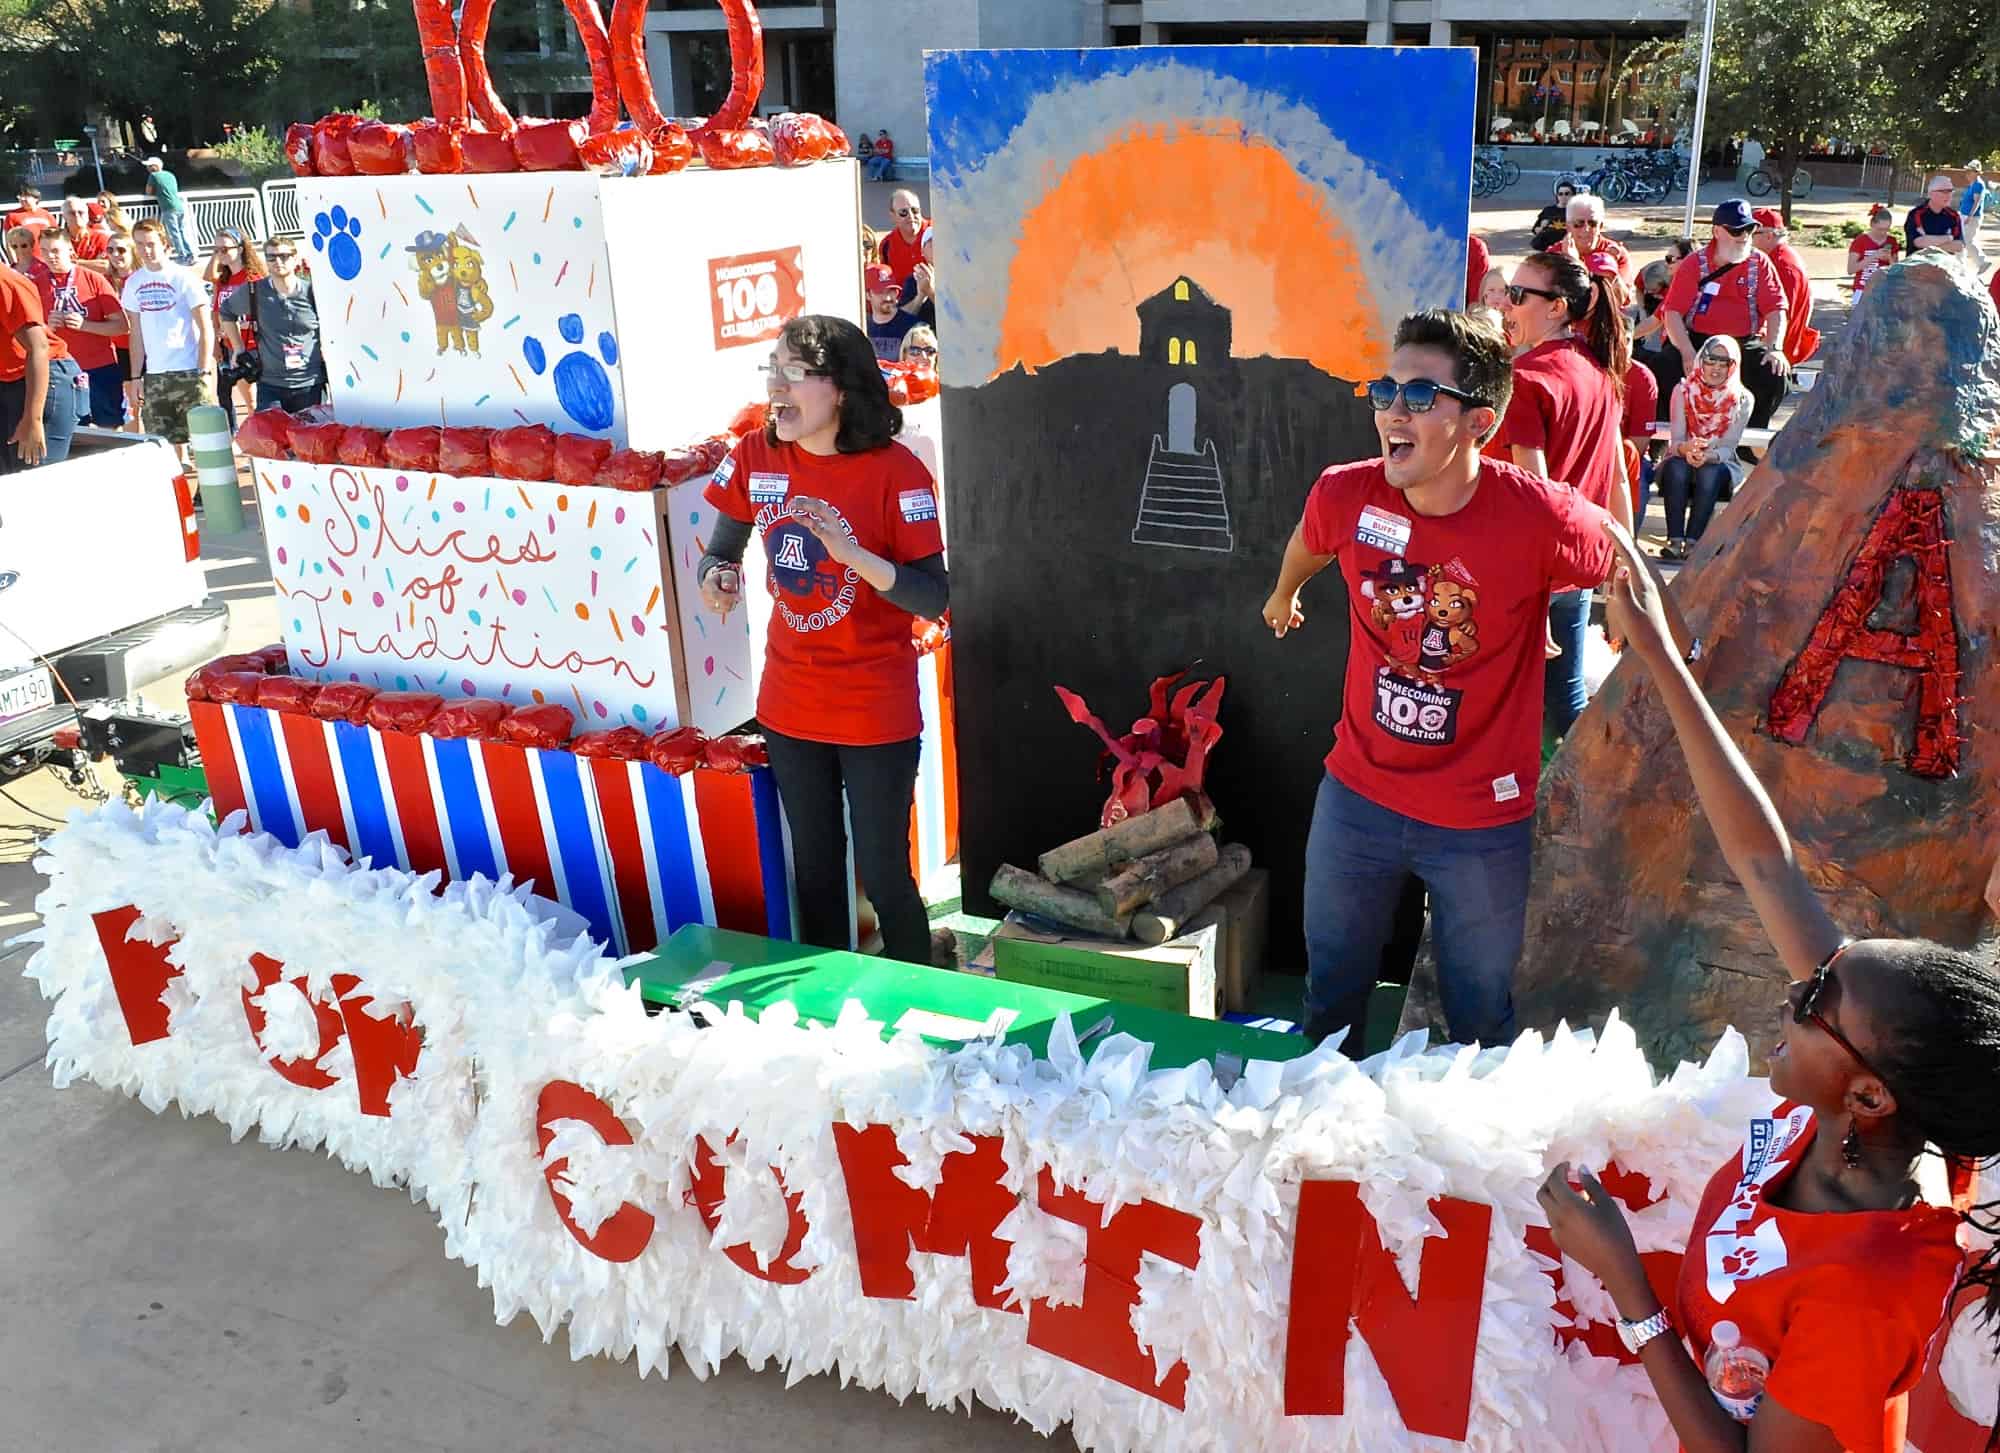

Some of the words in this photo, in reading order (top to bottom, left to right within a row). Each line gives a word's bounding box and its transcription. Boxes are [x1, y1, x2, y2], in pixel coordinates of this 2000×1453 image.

[717, 274, 779, 322] 100
[325, 468, 556, 565] Slices
[1372, 521, 1397, 536] BUFFS
[775, 533, 810, 572] A
[402, 564, 463, 615] of
[291, 586, 656, 688] Tradition
[1767, 487, 1968, 778] A
[0, 679, 47, 712] M7190
[1378, 676, 1452, 706] HOMECOMING
[1378, 687, 1448, 732] 100
[1376, 711, 1446, 740] CELEBRATION
